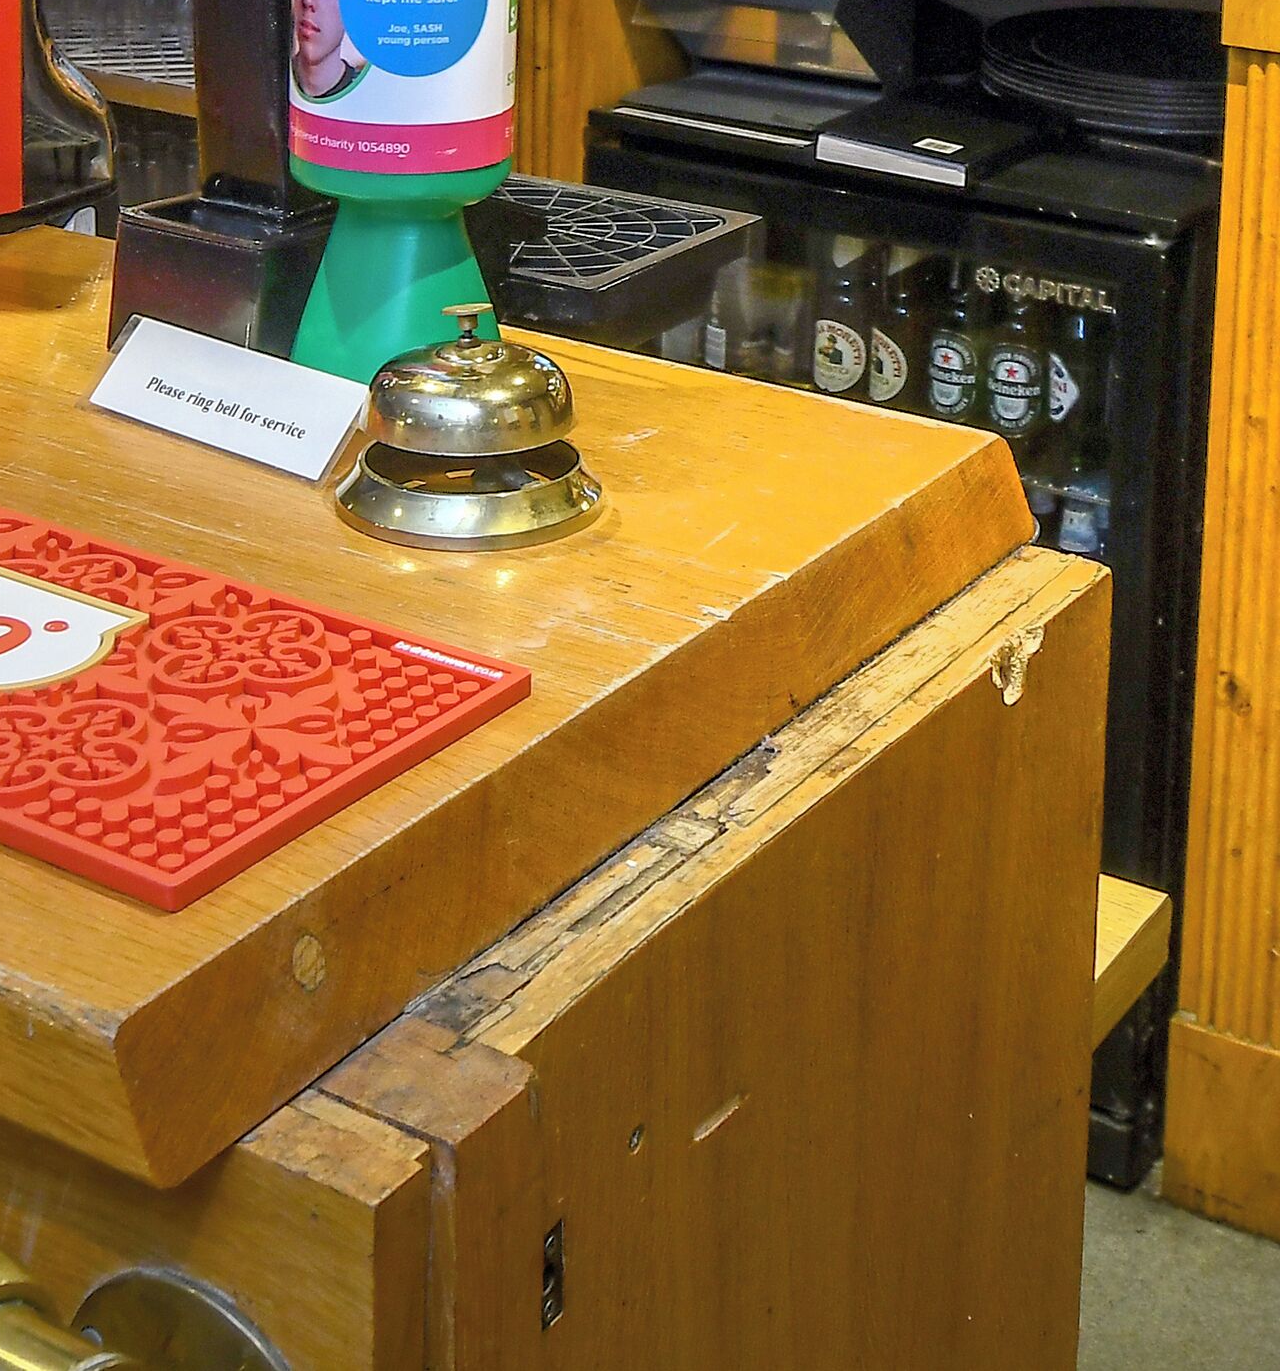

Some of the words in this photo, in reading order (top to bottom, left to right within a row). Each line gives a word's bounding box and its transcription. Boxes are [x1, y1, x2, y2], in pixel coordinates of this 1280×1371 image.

[377, 35, 411, 46] young
[413, 35, 450, 46] person
[388, 24, 411, 34] Joe,
[414, 23, 443, 33] SASH
[319, 136, 355, 152] charity
[357, 141, 411, 154] 1054890
[1002, 274, 1117, 314] CAPITAL
[875, 334, 901, 378] ORETTI
[145, 376, 186, 400] Please
[186, 392, 215, 413] ring
[214, 398, 240, 418] bell
[239, 407, 261, 426] for
[260, 414, 307, 439] service
